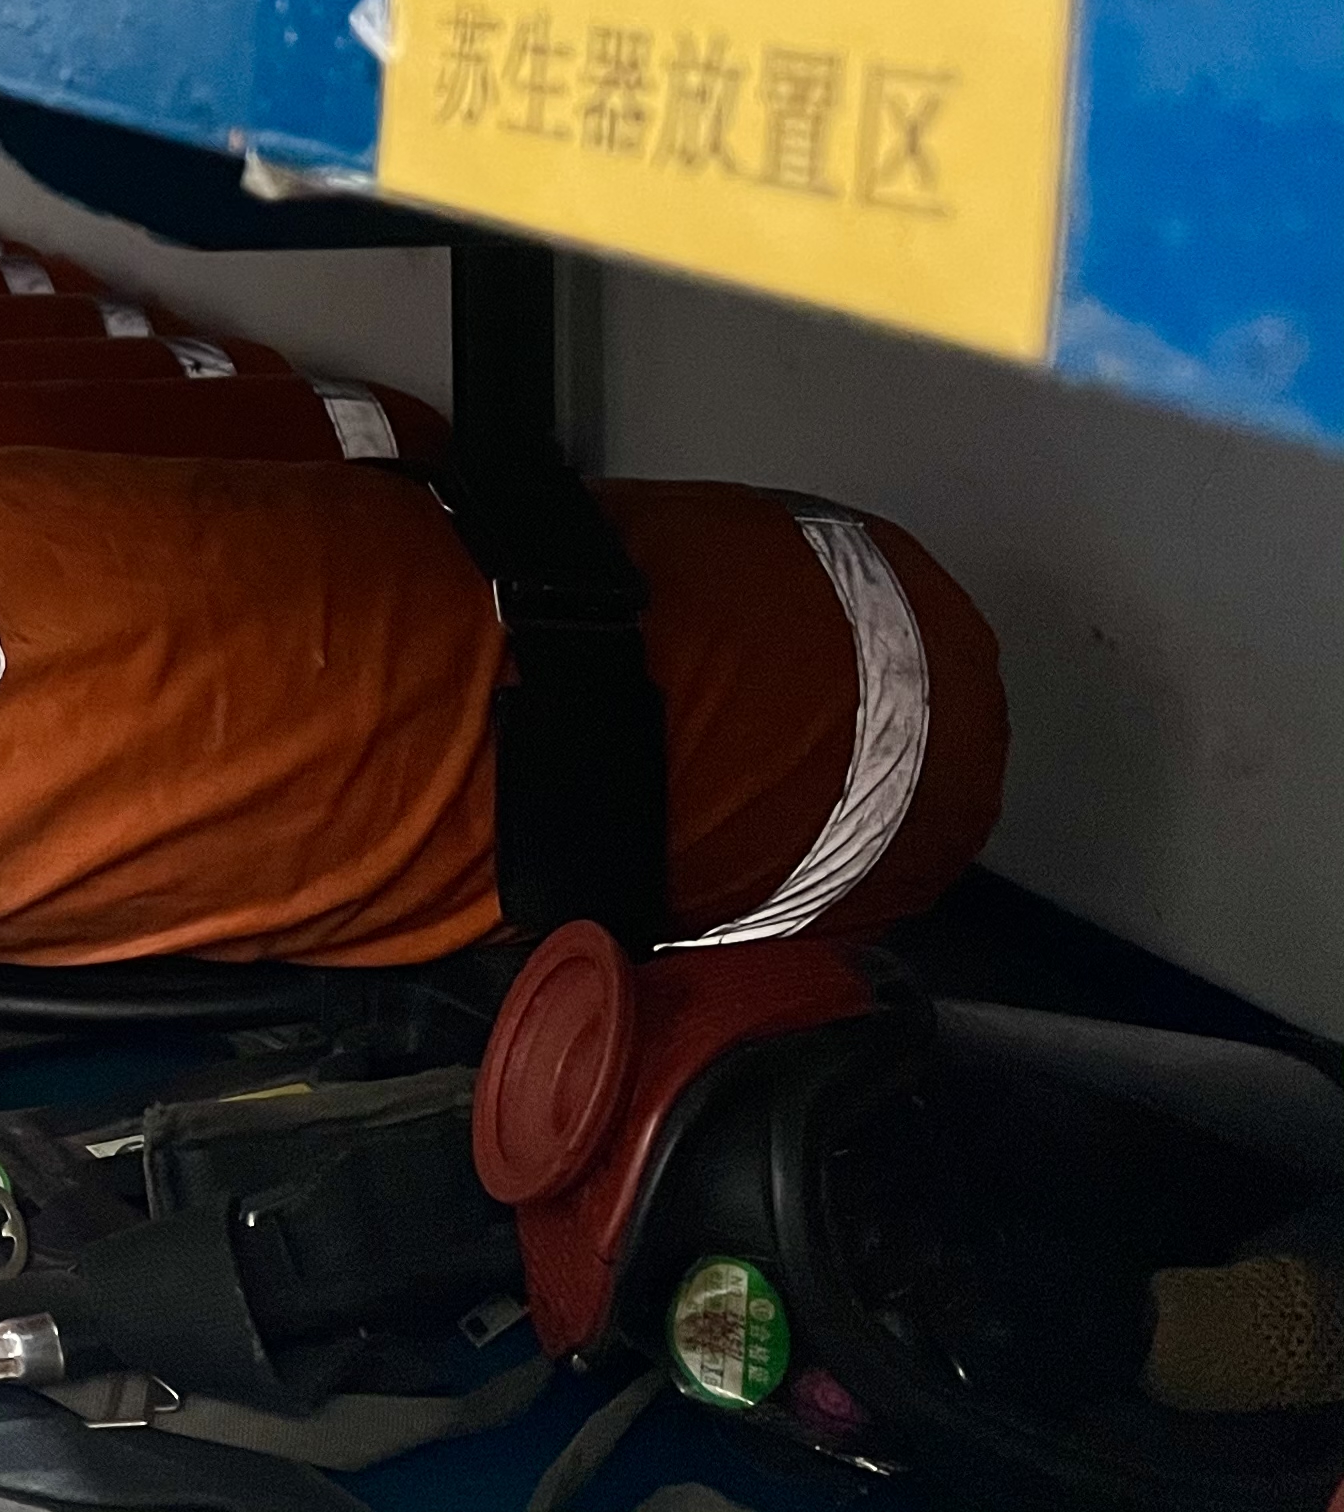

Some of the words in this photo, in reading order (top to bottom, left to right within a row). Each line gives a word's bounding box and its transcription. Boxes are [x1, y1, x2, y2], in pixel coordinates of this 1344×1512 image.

[432, 1, 959, 220] 苏生器放置区
